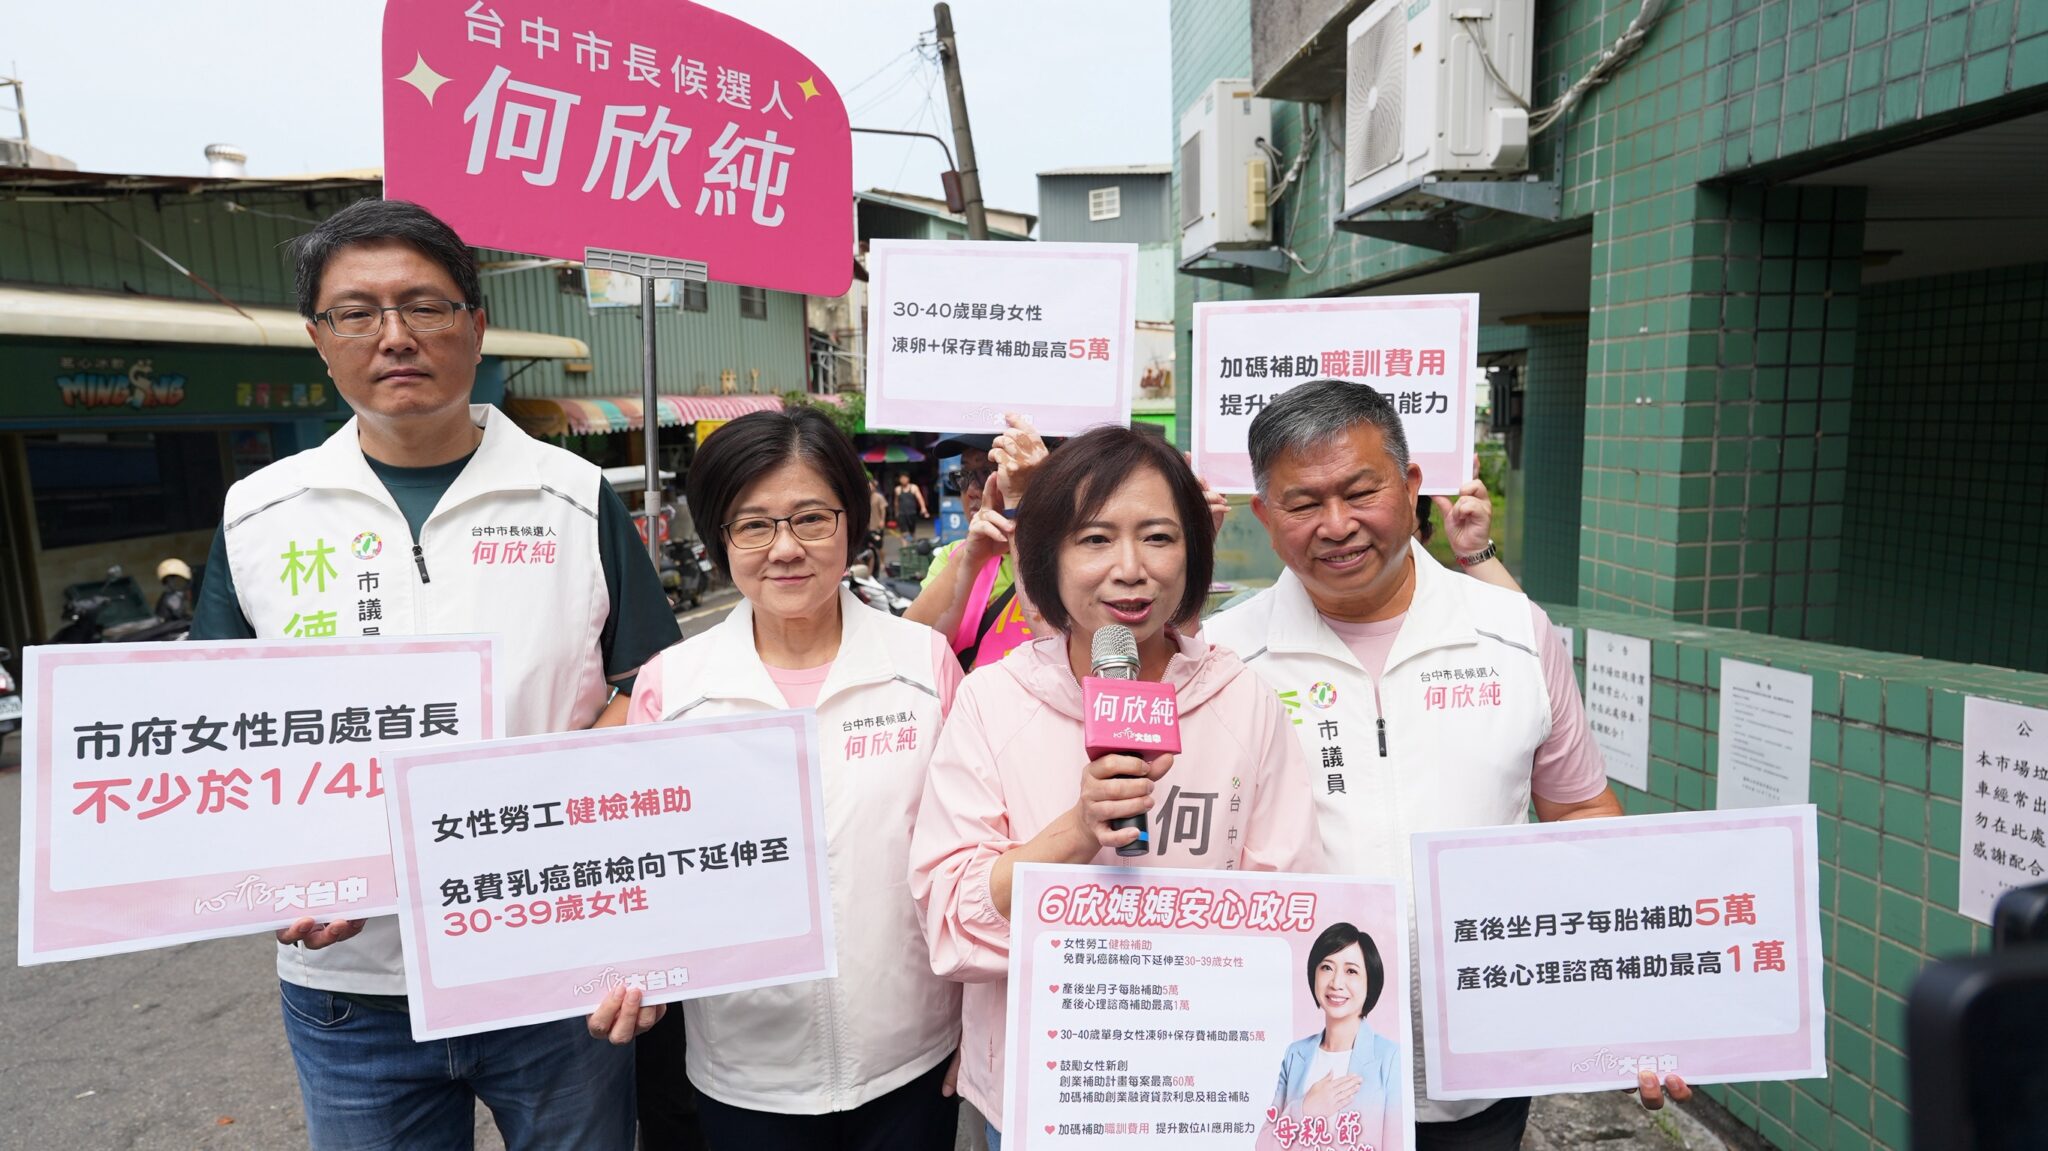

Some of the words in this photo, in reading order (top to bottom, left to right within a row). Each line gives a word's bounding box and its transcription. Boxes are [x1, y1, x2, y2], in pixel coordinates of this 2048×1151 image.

[464, 0, 794, 120] 台中市長候選人
[463, 65, 796, 228] 何欣純
[893, 301, 1043, 322] 30-40歲單身女性
[892, 336, 1110, 362] 凍卵+保存費補助最高5萬
[1219, 348, 1446, 379] 加碼補助職訓費用
[472, 526, 557, 538] 台中市長候選人
[472, 540, 557, 566] 何欣純
[1420, 666, 1500, 683] 台中市長候選人
[1093, 691, 1175, 728] 何欣純
[1424, 681, 1502, 712] 何欣純
[73, 702, 460, 760] 市府女性局處首長
[842, 710, 917, 732] 台中市長候選人
[844, 726, 918, 762] 何欣純
[1318, 719, 1347, 796] 市議員
[432, 785, 692, 843] 女性勞工健檢補助
[1155, 785, 1219, 858] 何
[439, 836, 790, 907] 免費乳癌篩檢向下延伸至
[443, 885, 649, 937] 30-39歲女性
[1038, 883, 1318, 933] 6欣媽媽安心政見
[1453, 892, 1757, 943] 產後坐月子每胎補助5萬
[1063, 938, 1153, 951] 女性勞工健檢補助
[1456, 940, 1786, 991] 產後心理諮商補助最高1萬
[1059, 1060, 1129, 1072] 鼓勵女性新創
[1273, 1111, 1362, 1150] 母親節
